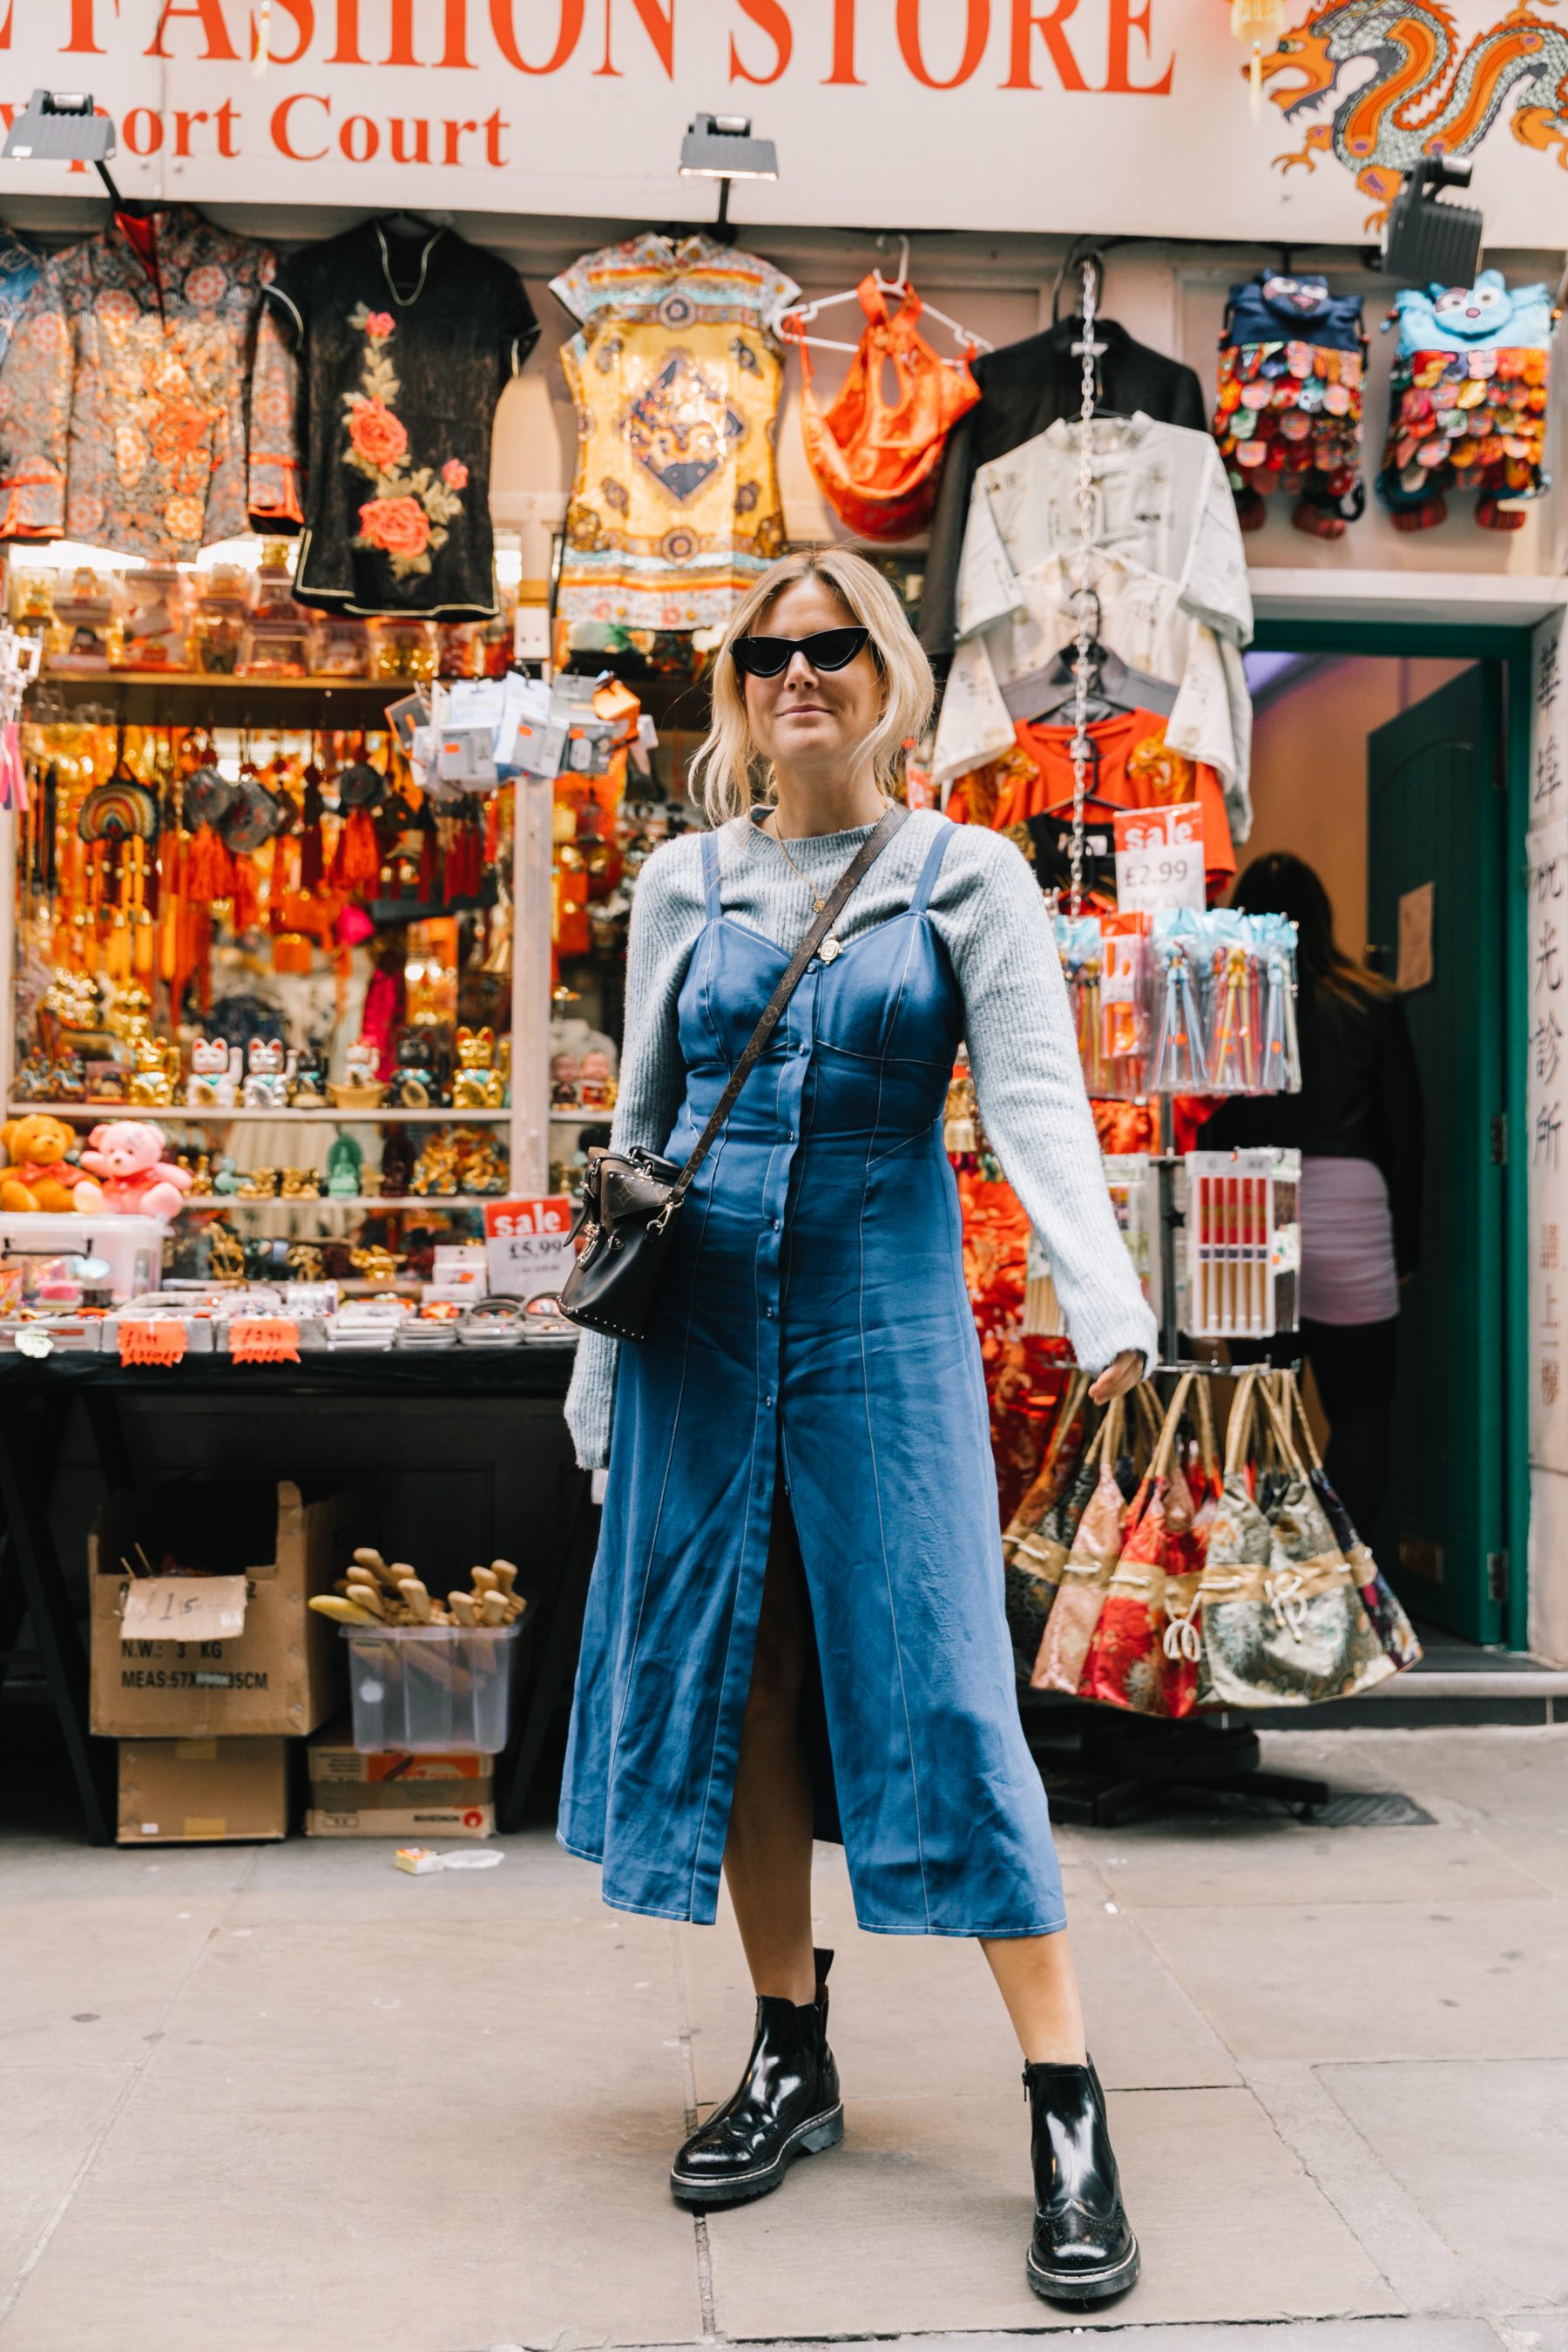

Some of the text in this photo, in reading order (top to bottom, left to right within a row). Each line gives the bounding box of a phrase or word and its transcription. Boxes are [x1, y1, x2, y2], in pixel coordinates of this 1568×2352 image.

[728, 0, 1177, 96] STORE
[270, 93, 510, 167] Court
[1125, 813, 1193, 850] sale
[1125, 860, 1188, 887] £2.99
[494, 1202, 561, 1236] sale
[510, 1239, 562, 1259] £5.99
[177, 1641, 186, 1659] 3
[199, 1641, 223, 1659] KG
